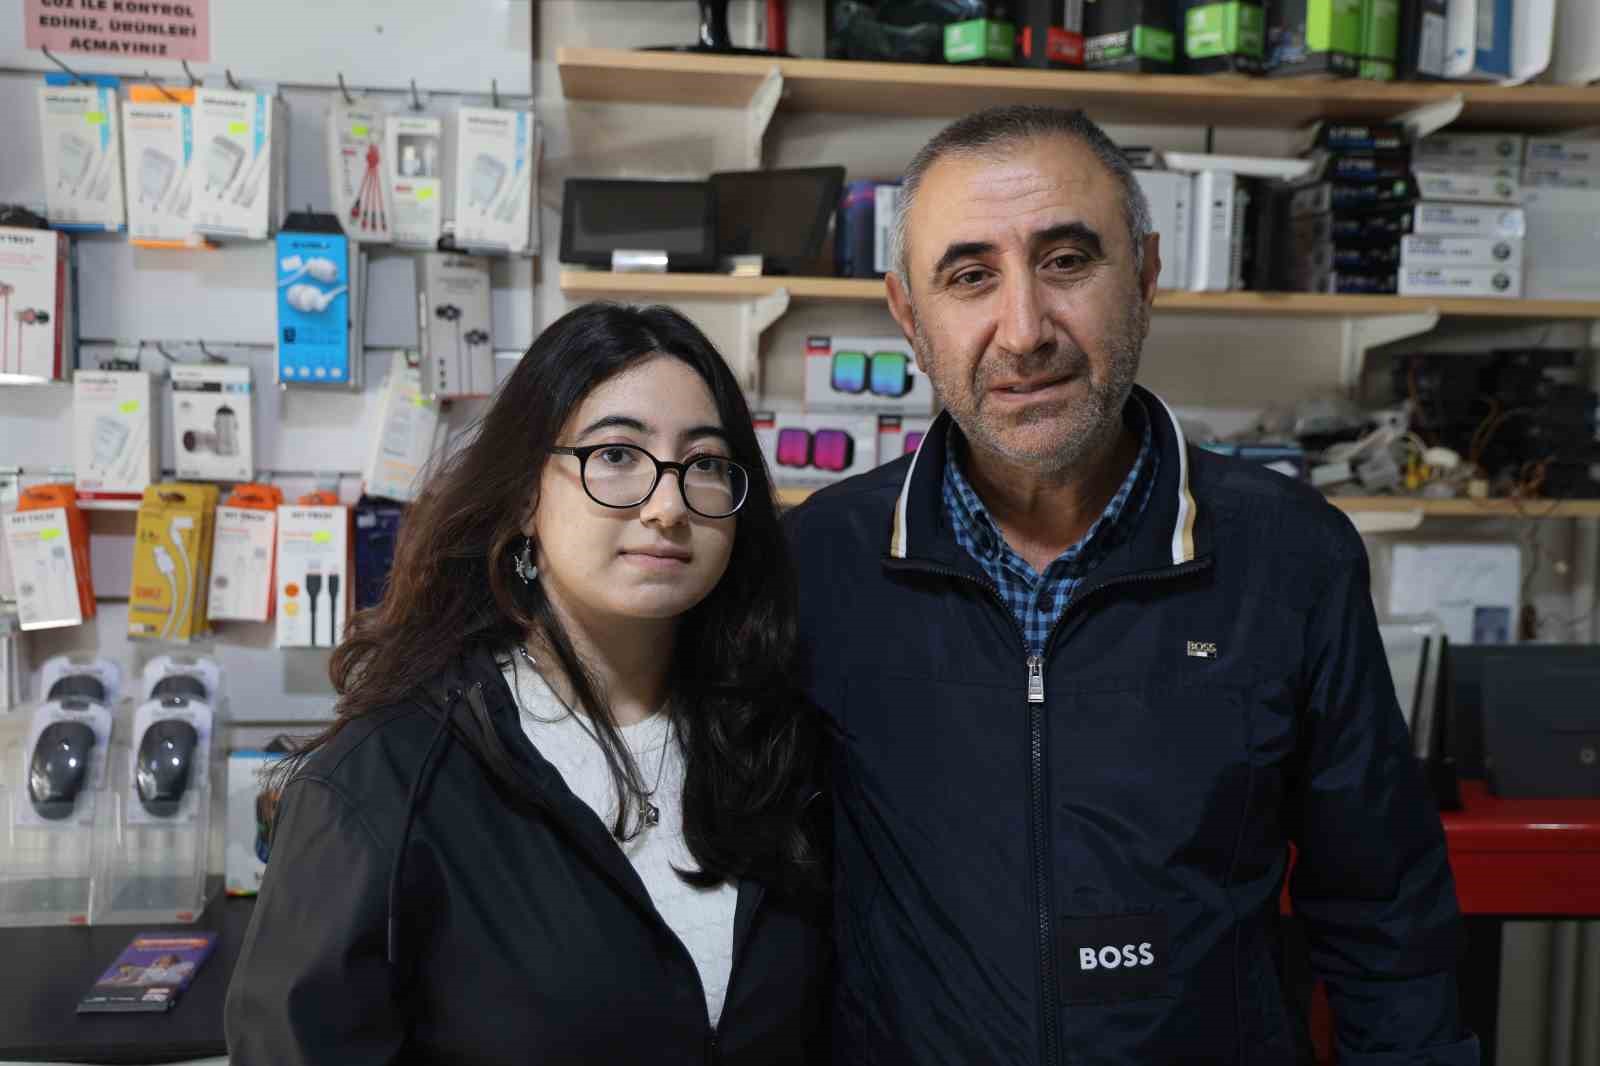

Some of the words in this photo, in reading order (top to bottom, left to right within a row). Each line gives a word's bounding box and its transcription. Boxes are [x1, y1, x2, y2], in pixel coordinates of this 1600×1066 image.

[113, 1, 194, 17] KONTROL
[70, 37, 168, 55] AÇMAYINIZ
[1187, 640, 1217, 653] BOSS
[1079, 942, 1154, 970] BOSS
